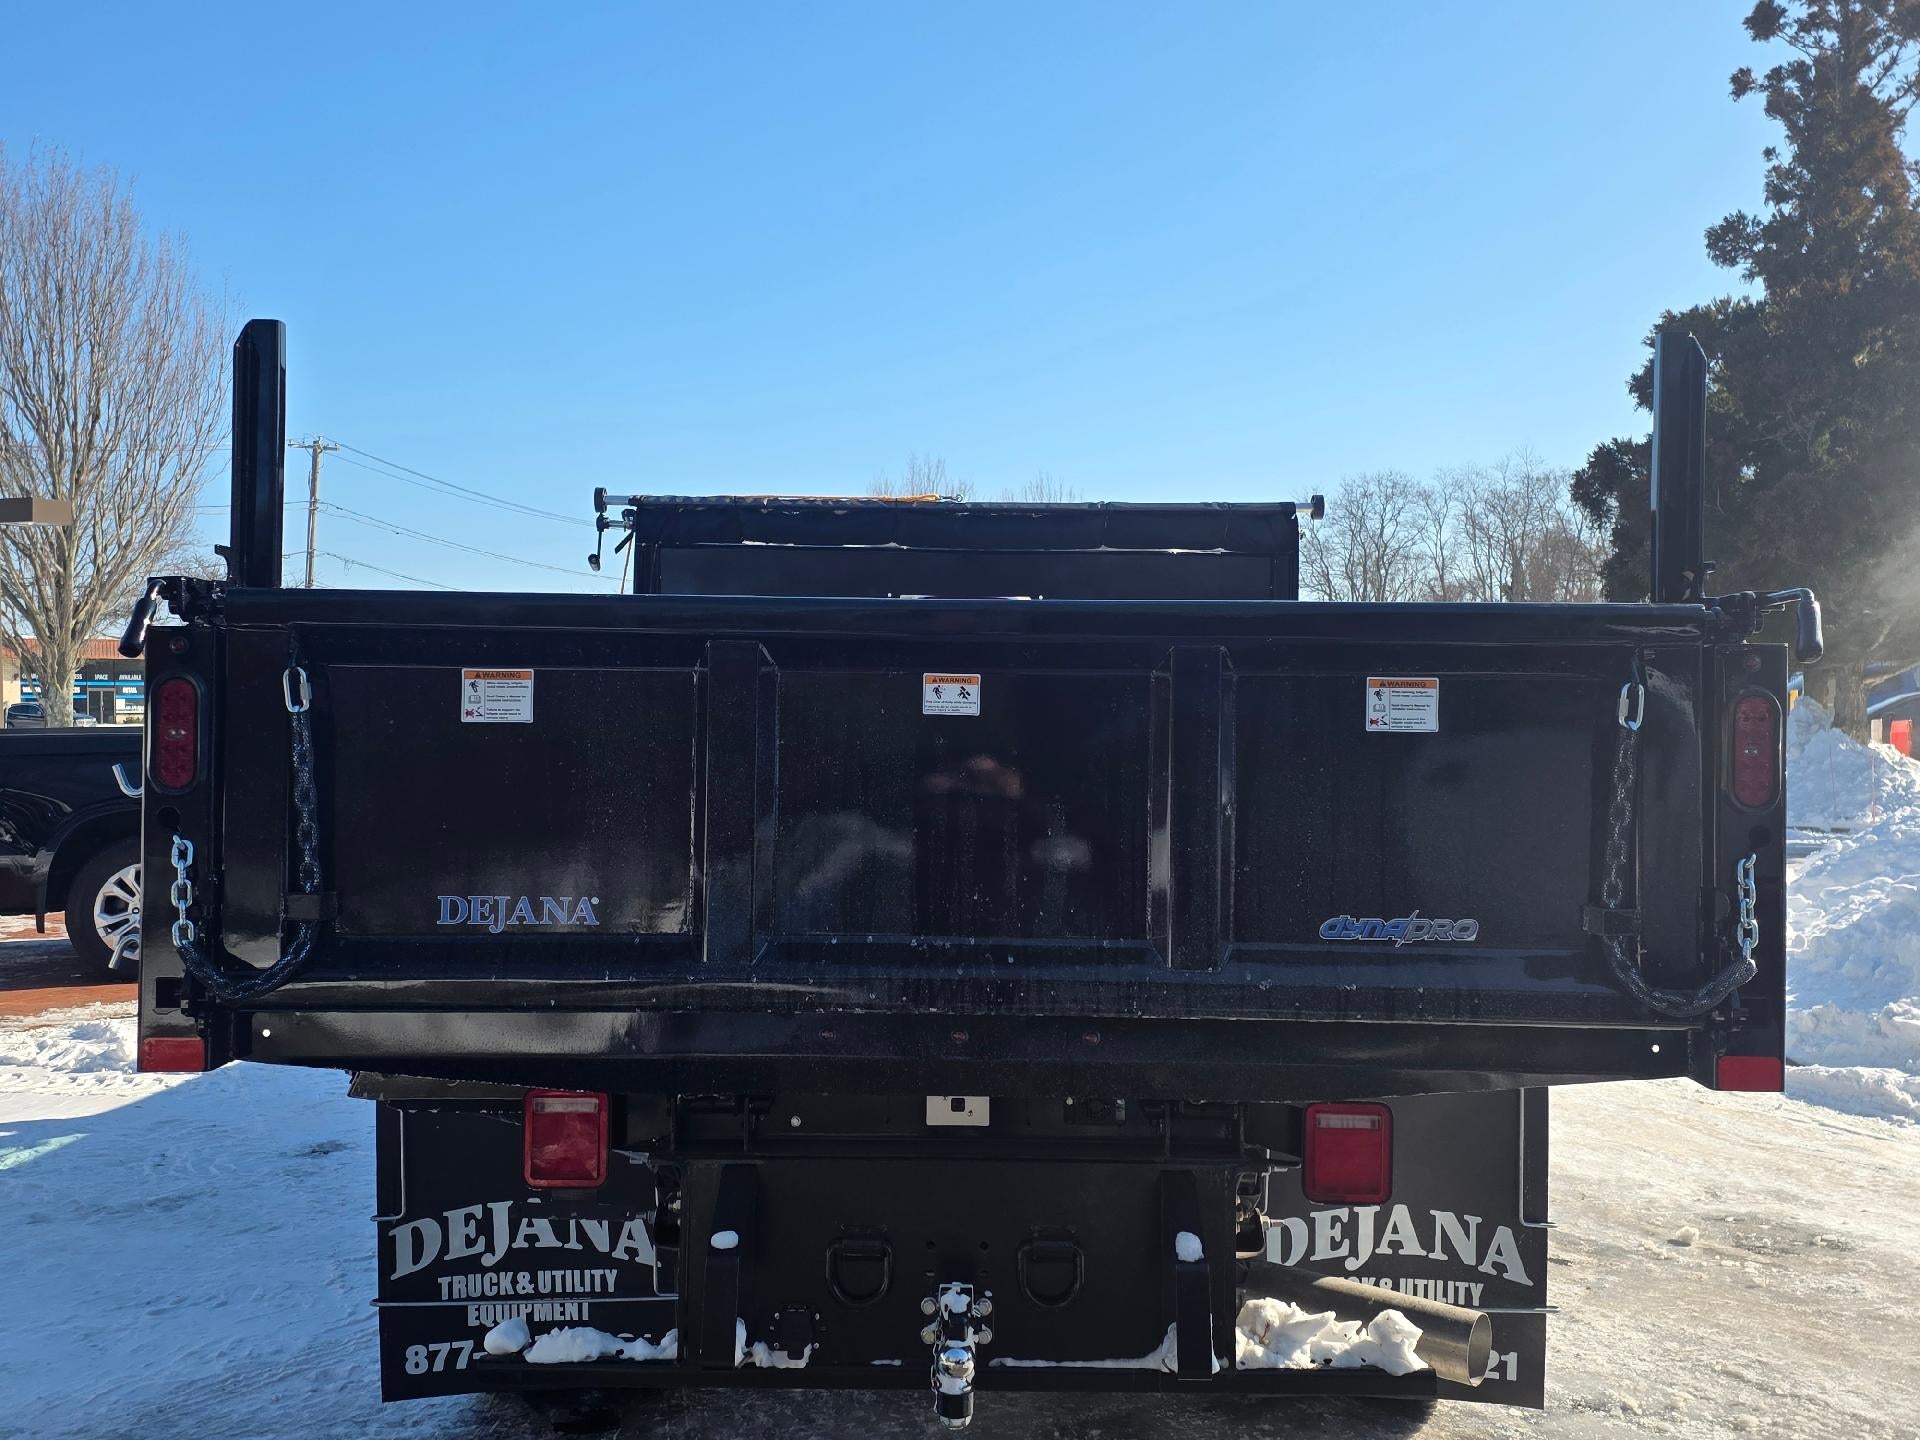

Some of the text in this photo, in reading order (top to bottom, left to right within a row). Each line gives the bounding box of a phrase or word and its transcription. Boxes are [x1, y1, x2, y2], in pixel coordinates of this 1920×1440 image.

[483, 671, 522, 679] WARNING
[388, 1199, 662, 1280] DEJANA
[1266, 1204, 1534, 1286] DEJANA
[538, 1269, 618, 1293] UTILITY
